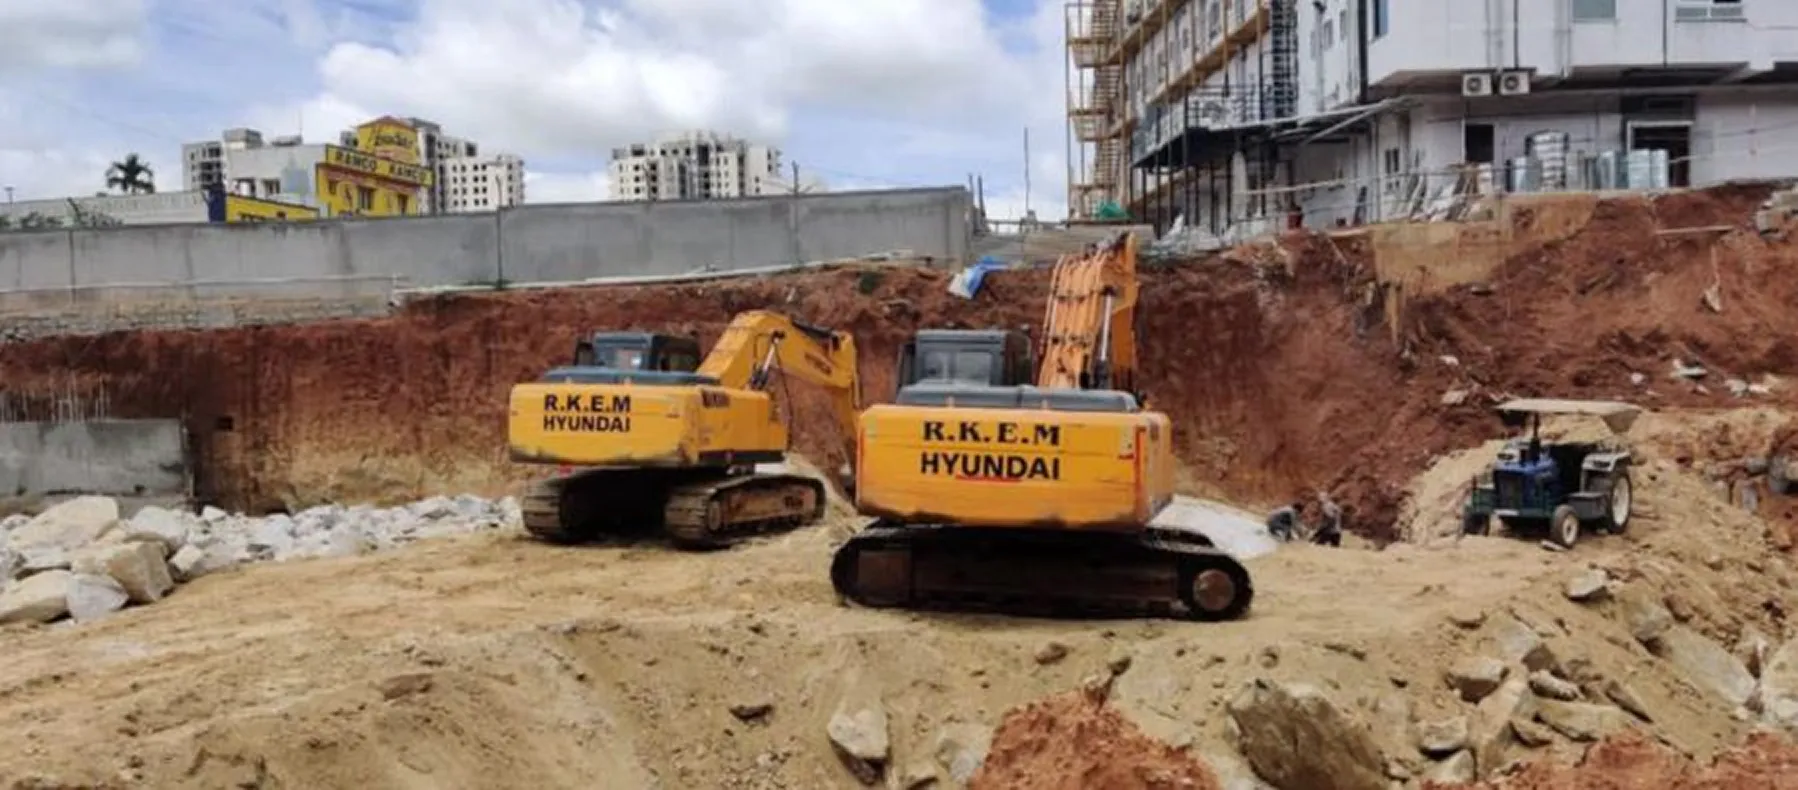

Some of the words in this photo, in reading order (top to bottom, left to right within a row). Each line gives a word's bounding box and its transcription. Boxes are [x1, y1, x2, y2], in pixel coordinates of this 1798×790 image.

[544, 394, 631, 413] R.K.E.M
[543, 414, 631, 433] HYUNDAI
[923, 421, 1060, 446] R.K.E.M
[920, 451, 1060, 480] HYUNDAI
